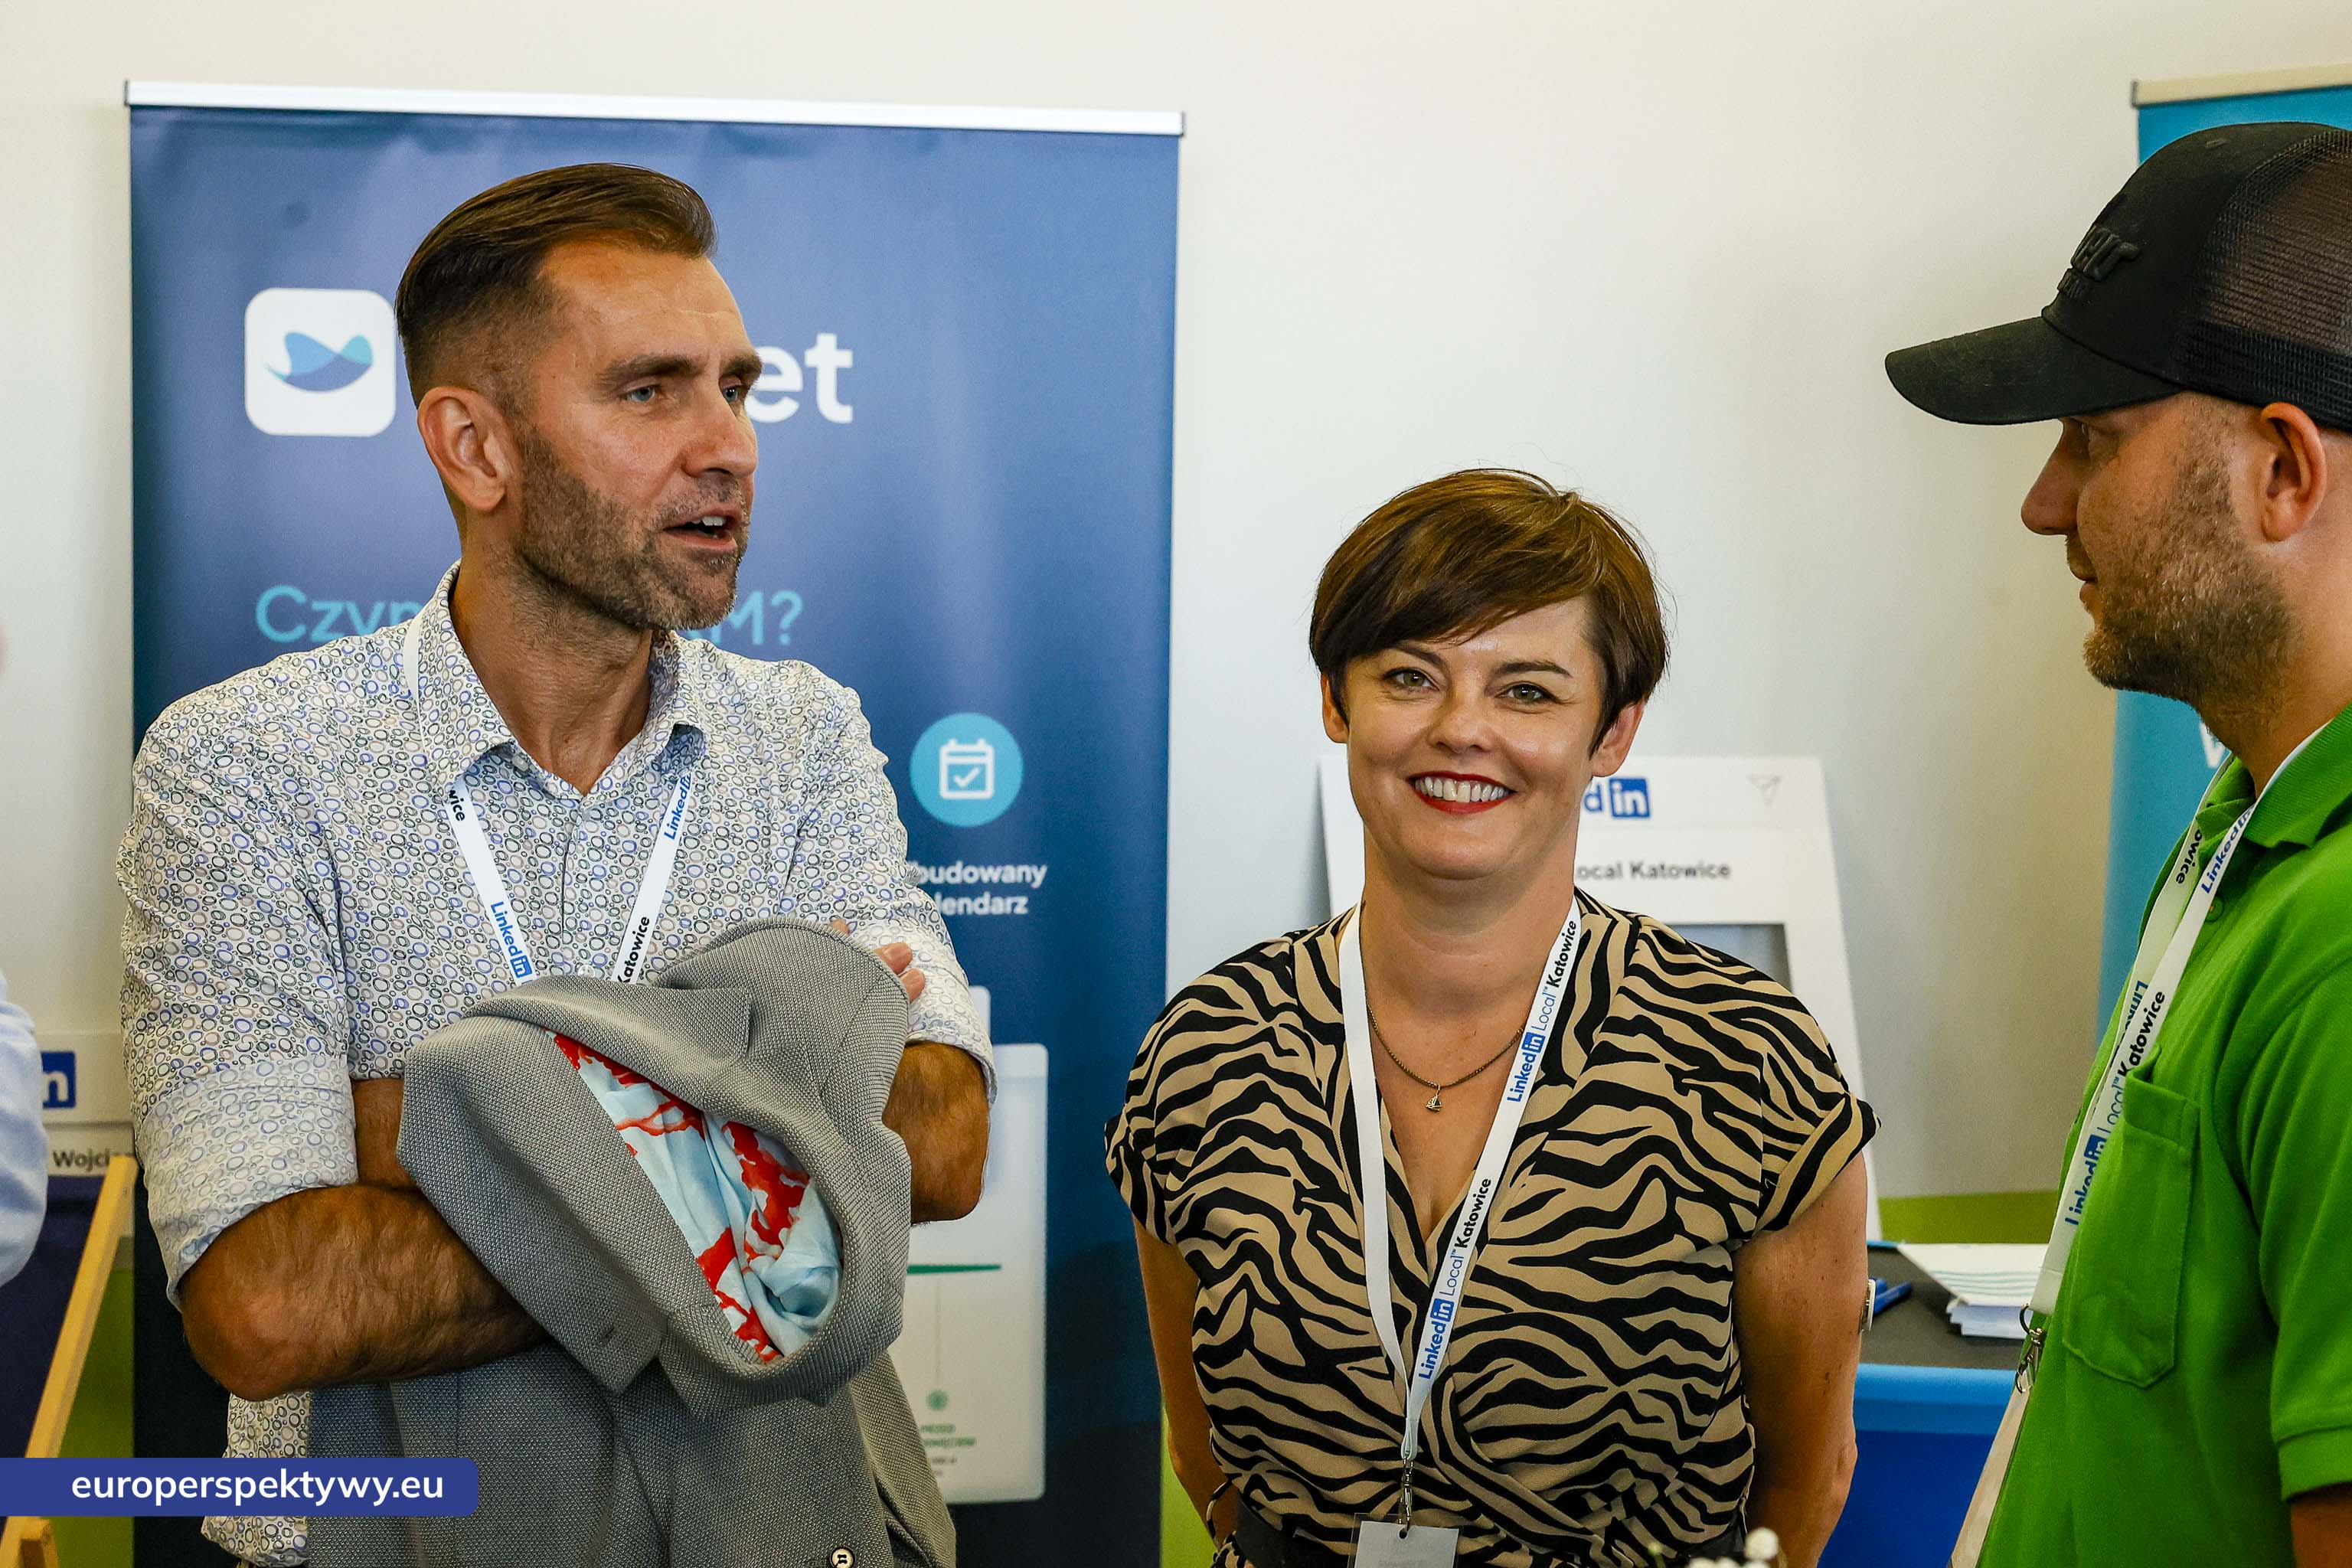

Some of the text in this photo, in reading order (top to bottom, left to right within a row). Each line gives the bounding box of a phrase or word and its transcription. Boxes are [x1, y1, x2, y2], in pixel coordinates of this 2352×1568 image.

[909, 860, 1047, 889] budowany
[1577, 858, 1731, 879] ocal Katowice
[2176, 829, 2203, 884] owice
[2201, 809, 2252, 894] Linked
[934, 890, 1029, 916] lendarz
[1545, 920, 1577, 988] Katowice
[2117, 991, 2165, 1077] Katowice
[1454, 1178, 1491, 1249] Katowice
